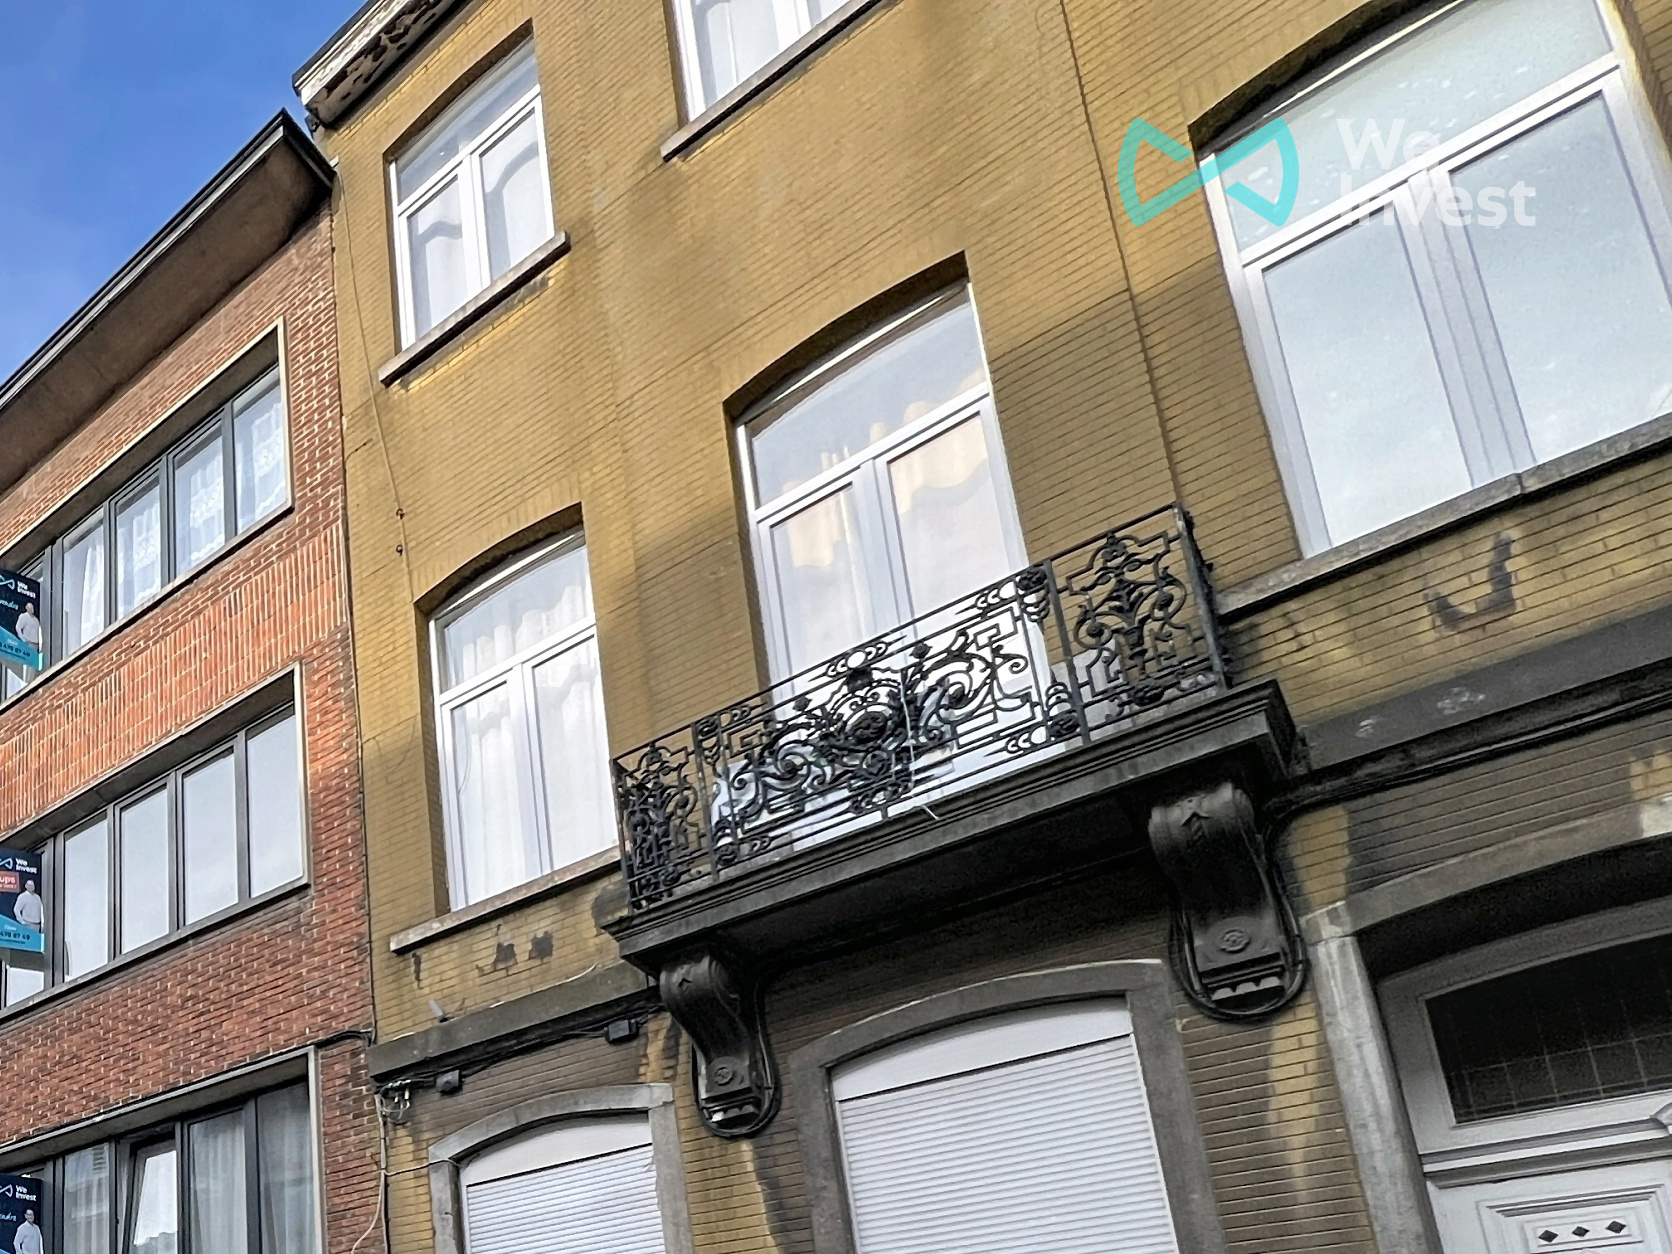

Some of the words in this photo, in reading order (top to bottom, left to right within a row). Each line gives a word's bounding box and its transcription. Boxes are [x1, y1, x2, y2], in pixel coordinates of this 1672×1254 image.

[15, 857, 27, 866] We
[15, 864, 37, 874] Invest
[15, 1184, 28, 1193] We
